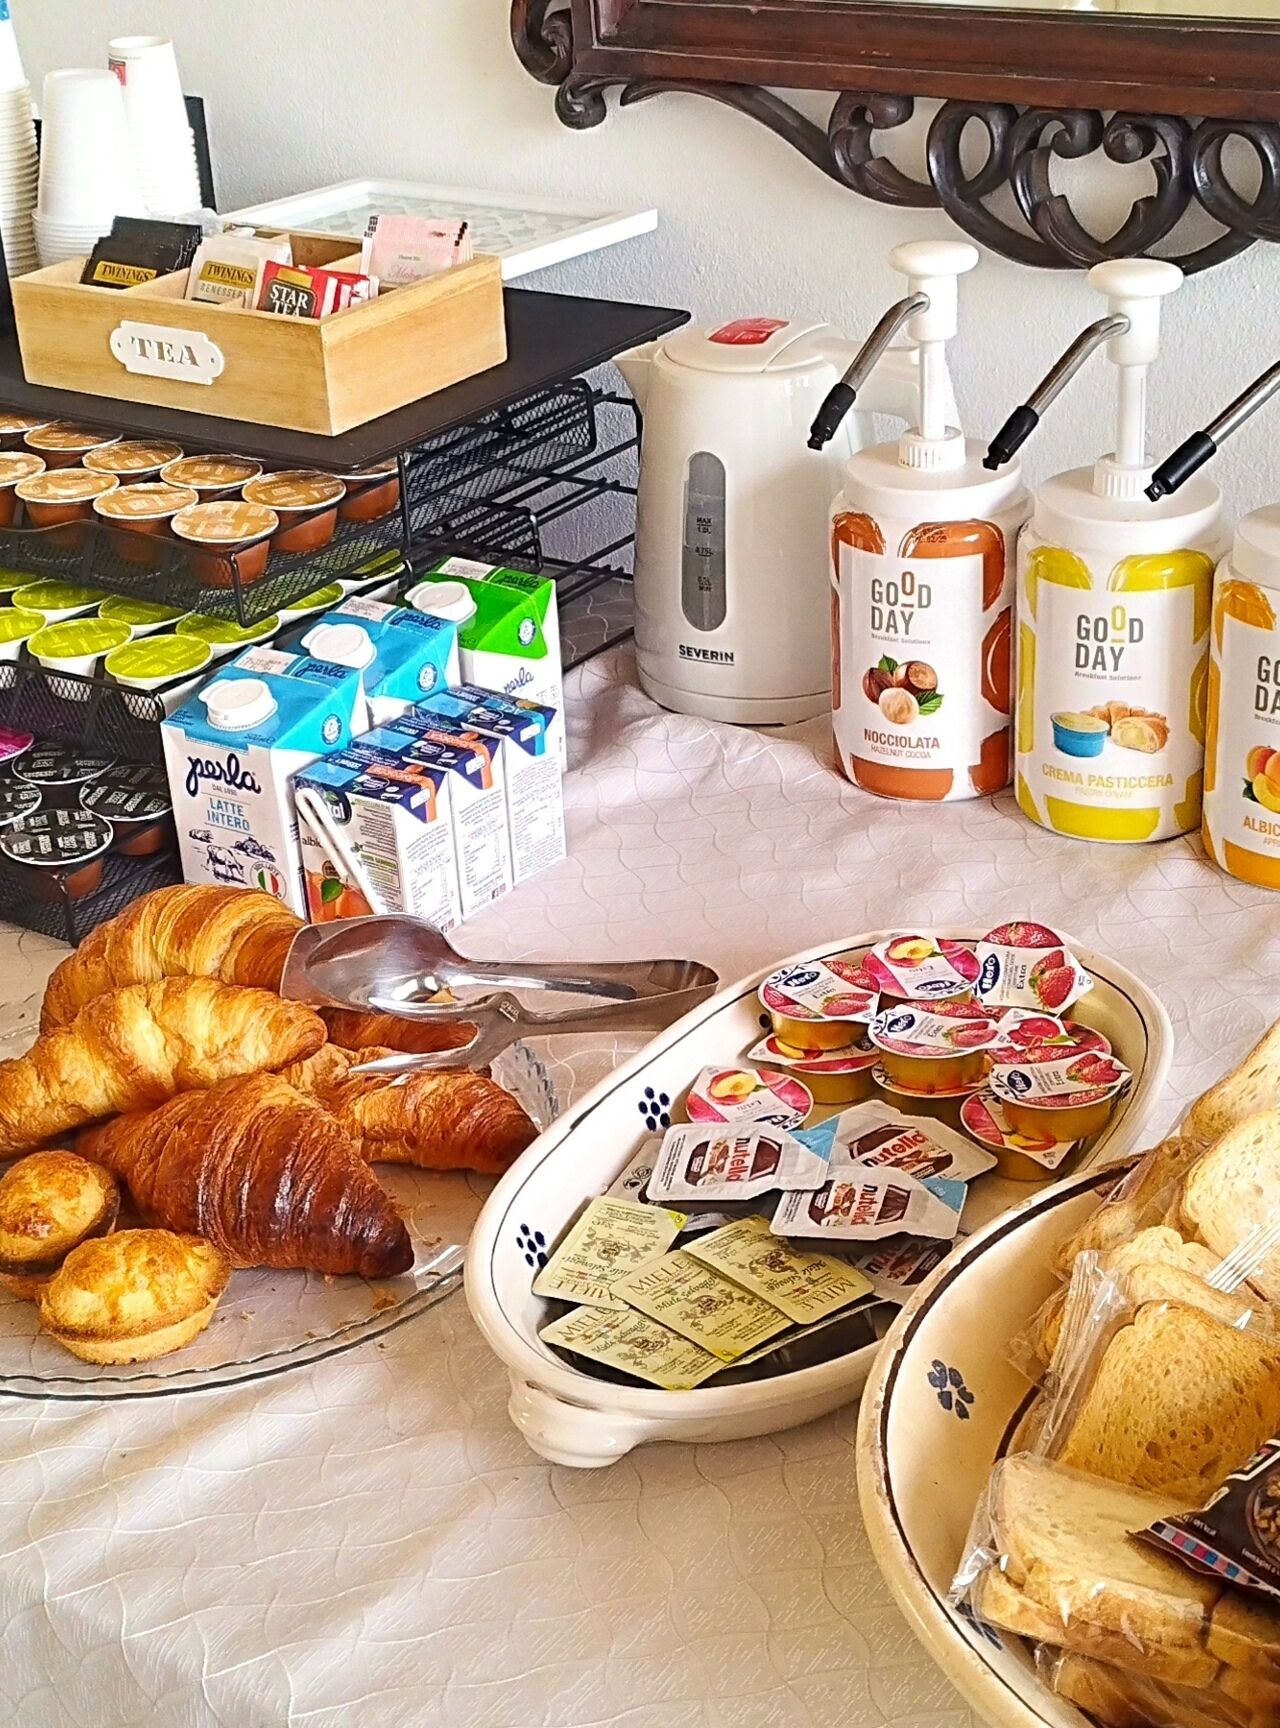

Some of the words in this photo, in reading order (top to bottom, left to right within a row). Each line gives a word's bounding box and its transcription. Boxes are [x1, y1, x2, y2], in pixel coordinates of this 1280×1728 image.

[102, 264, 153, 283] TWININGS
[207, 264, 255, 284] TWININGS
[270, 284, 309, 309] STAR
[272, 300, 301, 317] TEA
[129, 335, 200, 368] TEA
[494, 572, 540, 589] perla
[871, 571, 932, 608] GOOD
[390, 609, 442, 630] perla
[870, 606, 915, 636] DAY
[1076, 605, 1144, 643] GOOD
[678, 644, 735, 663] SEVERIN
[1075, 642, 1125, 672] DAY
[294, 661, 348, 680] perla
[864, 728, 940, 749] NOCCIOLATA
[185, 753, 262, 797] perla
[1042, 762, 1084, 786] CREMA
[1087, 773, 1174, 789] PASTICCERA
[209, 797, 245, 817] LATTE
[206, 810, 250, 832] INTERO
[786, 971, 819, 988] Hero
[981, 956, 998, 991] Hero
[1016, 964, 1028, 990] Extra
[725, 1137, 751, 1183] nutella
[861, 1130, 930, 1168] nutella
[850, 1184, 879, 1226] nutella
[629, 1257, 691, 1296] MIELE
[799, 1275, 857, 1312] MIELE
